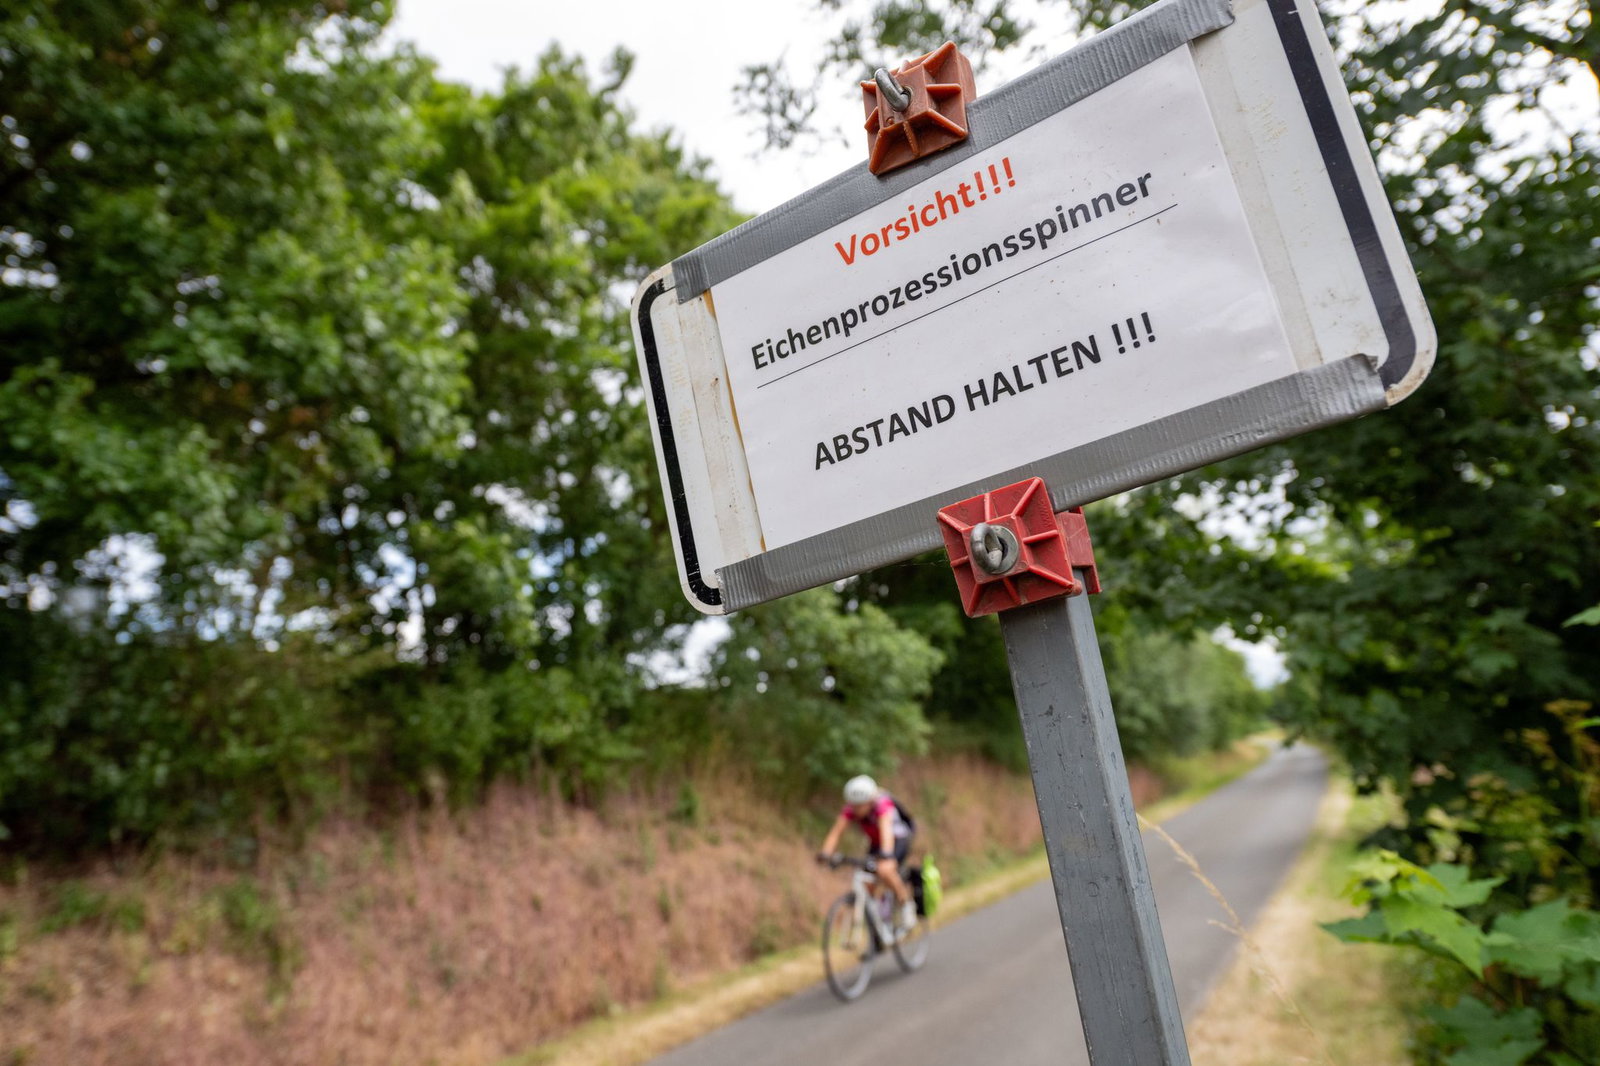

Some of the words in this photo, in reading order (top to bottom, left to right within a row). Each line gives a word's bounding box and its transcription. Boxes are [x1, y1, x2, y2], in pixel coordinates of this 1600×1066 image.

[752, 172, 1152, 370] Eichenprozessionsspinner
[834, 157, 1016, 265] Vorsicht!!!
[815, 394, 956, 471] ABSTAND
[964, 335, 1102, 412] HALTEN
[1111, 311, 1157, 355] !!!
